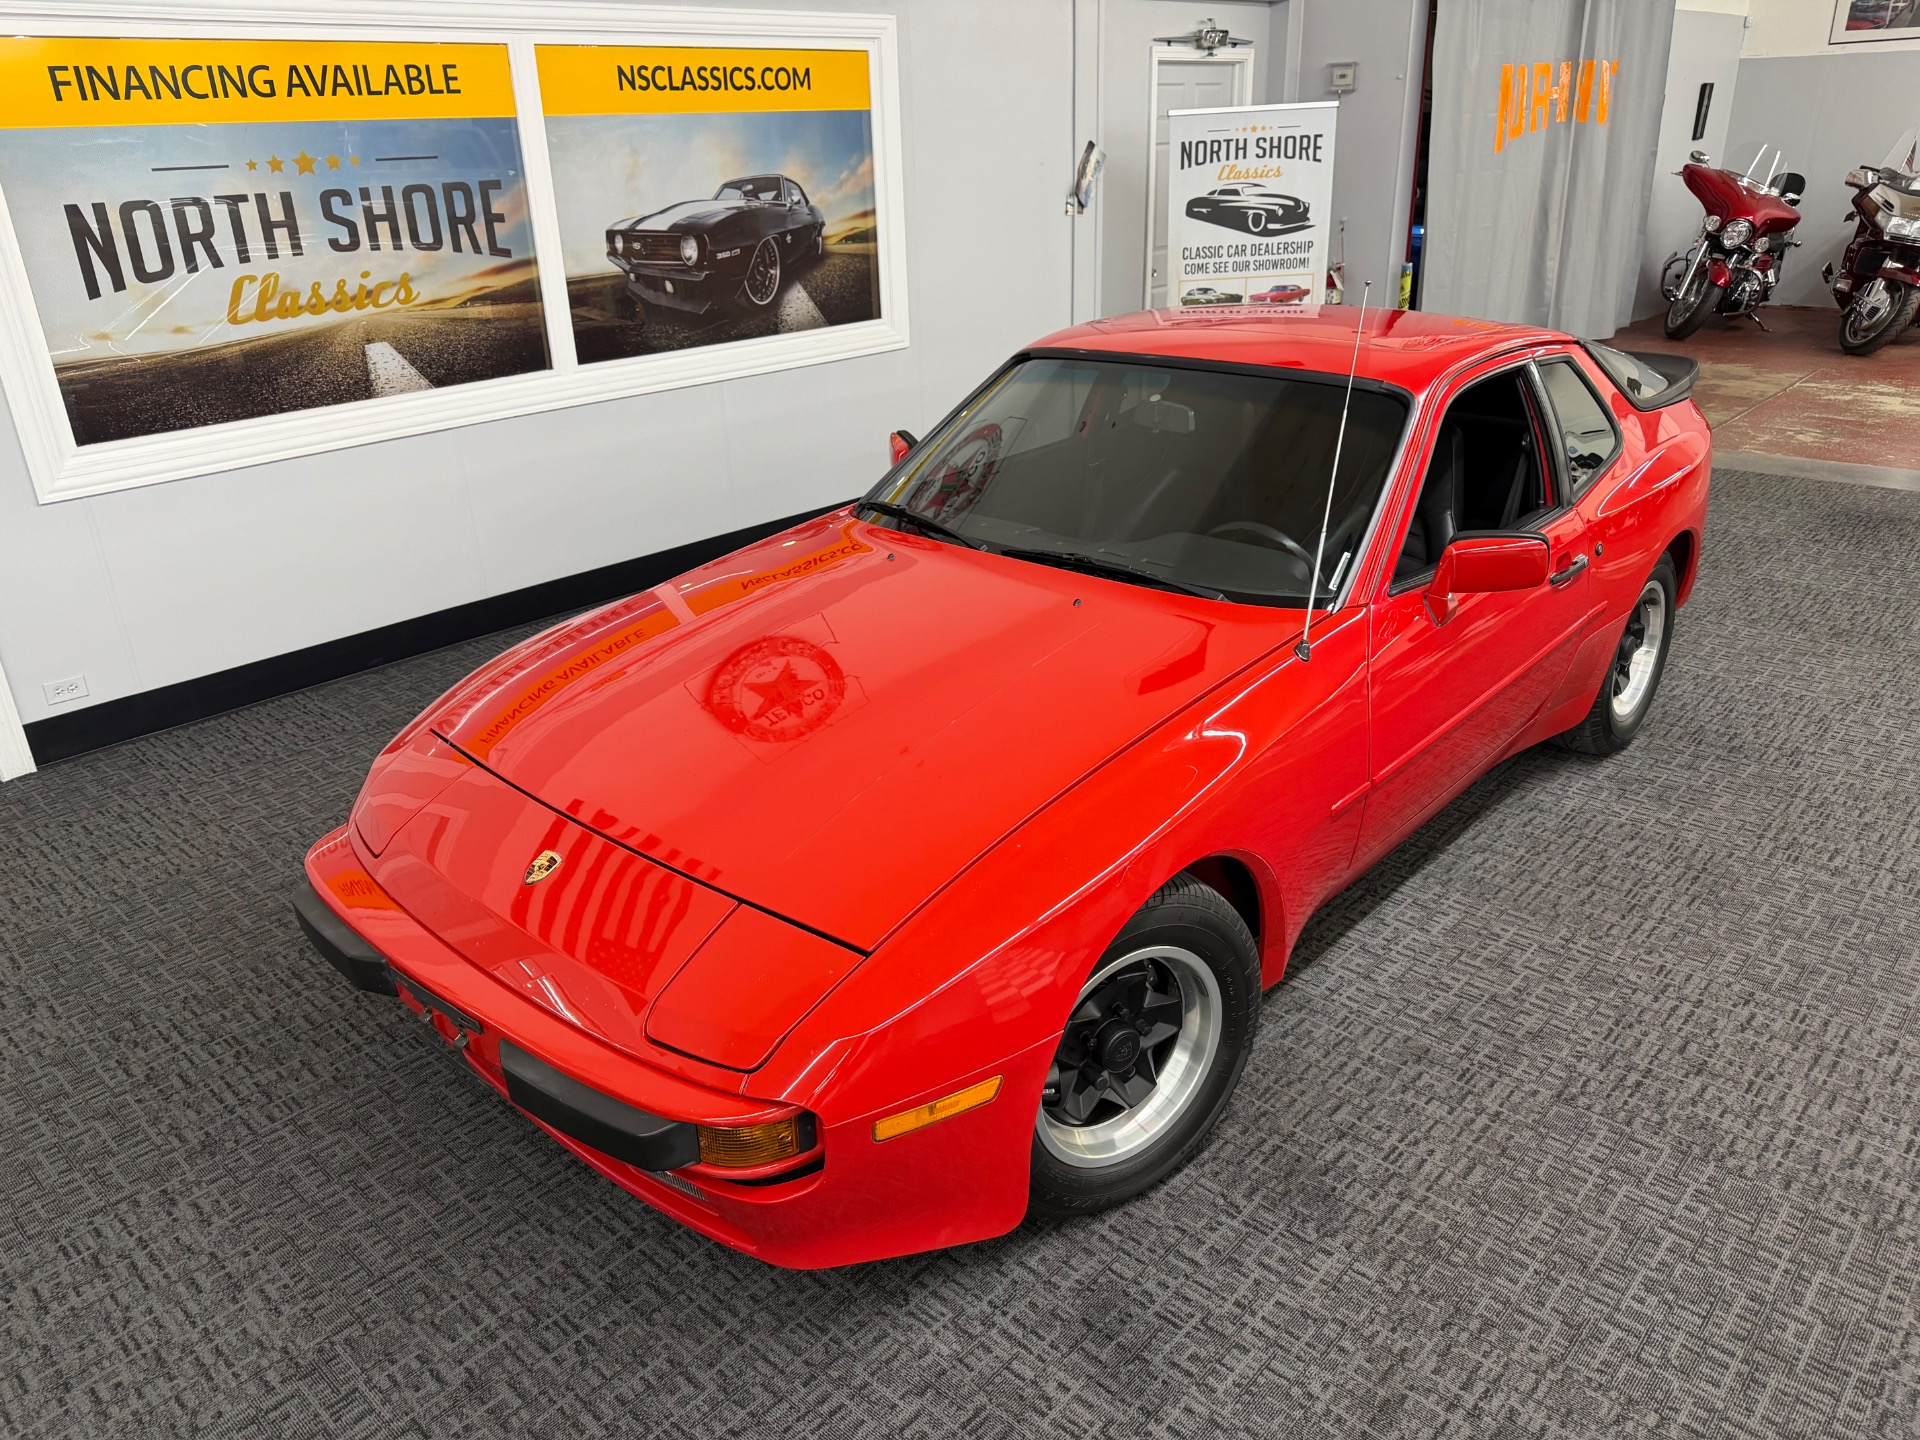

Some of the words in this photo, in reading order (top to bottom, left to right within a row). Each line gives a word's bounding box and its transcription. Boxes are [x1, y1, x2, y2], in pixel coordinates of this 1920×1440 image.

[47, 64, 276, 102] FINANCING
[286, 63, 462, 98] AVAILABLE
[616, 64, 812, 92] NSCLASSICS.COM
[1180, 138, 1247, 170] NORTH
[1255, 134, 1323, 163] SHORE
[1217, 164, 1284, 181] Classics
[63, 191, 304, 301] NORTH
[321, 179, 513, 259] SHORE
[1182, 245, 1224, 260] CLASSIC
[1227, 243, 1247, 258] CAR
[1250, 240, 1314, 257] DEALERSHIP
[1184, 262, 1210, 275] COME
[1212, 261, 1229, 273] SEE
[1232, 260, 1251, 272] OUR
[1252, 257, 1310, 271] SHOWROOM!
[226, 268, 421, 325] Classics
